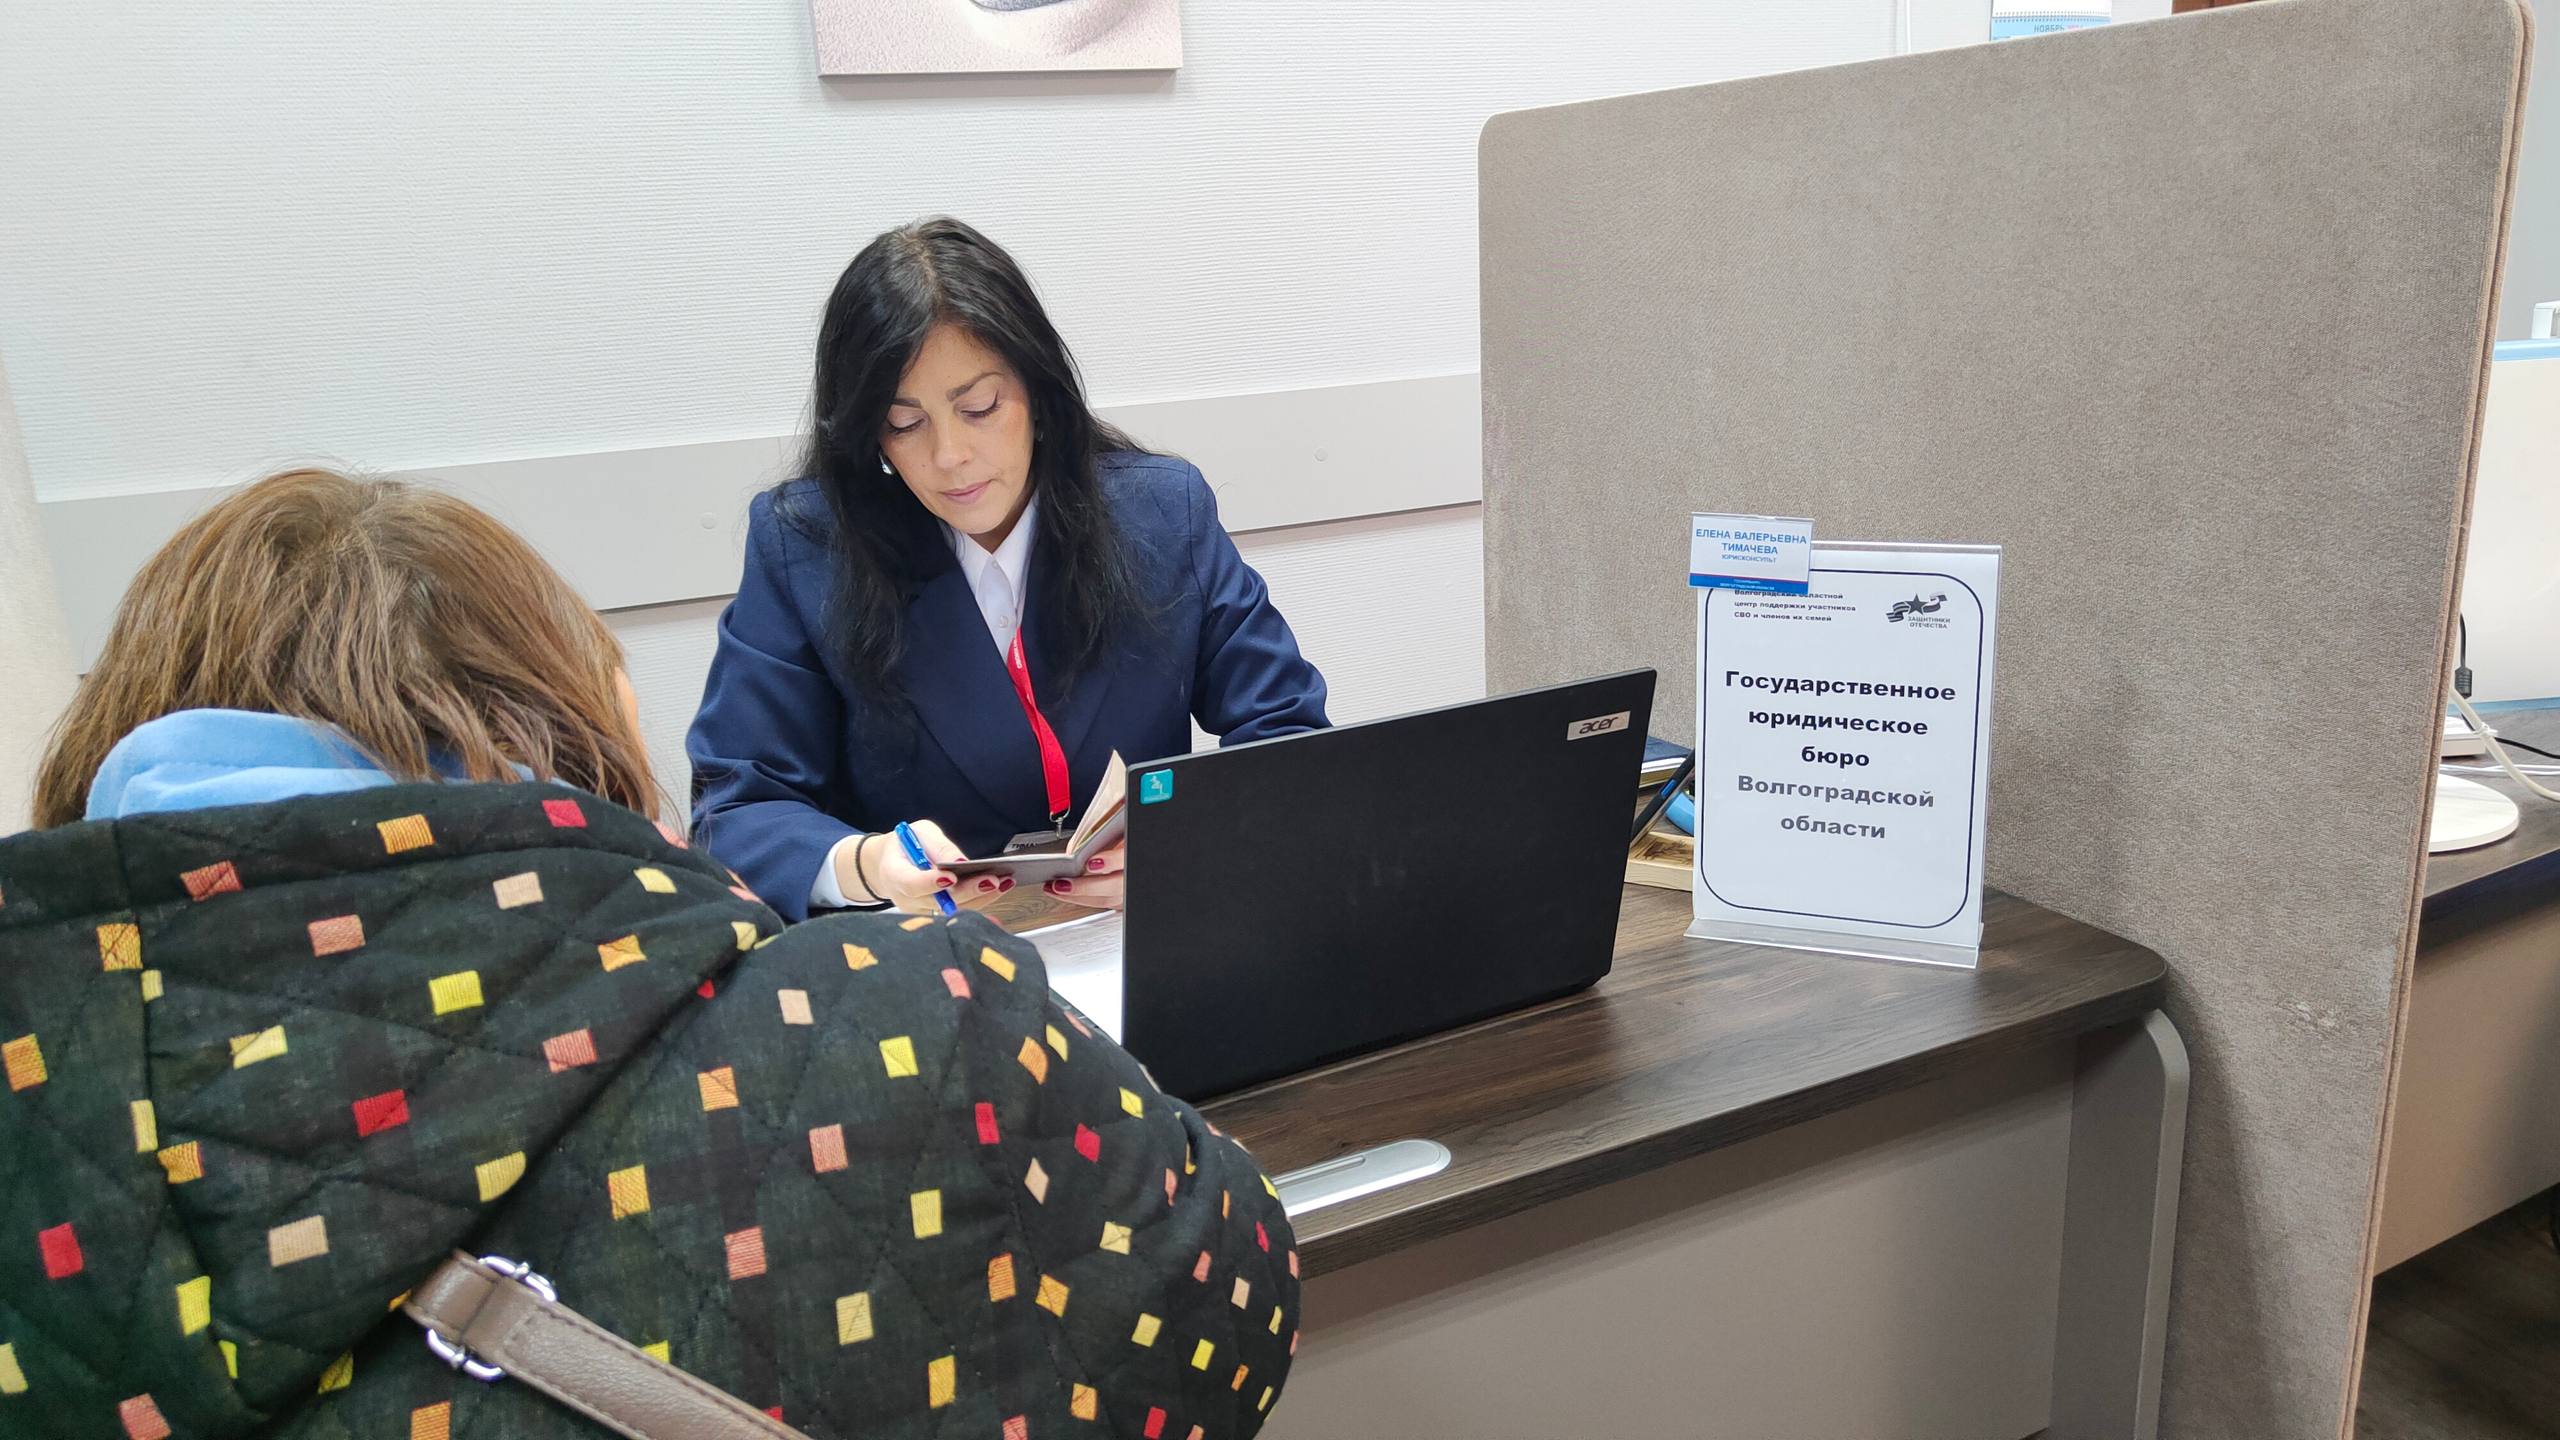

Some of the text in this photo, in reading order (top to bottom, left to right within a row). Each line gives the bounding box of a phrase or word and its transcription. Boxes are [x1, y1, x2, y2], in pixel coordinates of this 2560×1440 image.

[1696, 529, 1807, 544] ЕЛЕНА ВАЛЕРЬЕВНА
[1722, 542, 1778, 554] ТИМАЧЕВА
[1760, 603, 1806, 611] поддержки
[1808, 604, 1856, 612] участников
[1805, 614, 1832, 622] семей
[1726, 671, 1956, 701] Государственное
[1579, 716, 1619, 734] acer
[1748, 711, 1928, 735] юридическое
[1801, 746, 1870, 769] бюро
[1738, 775, 1934, 808] Волгоградской
[1780, 816, 1886, 839] области
